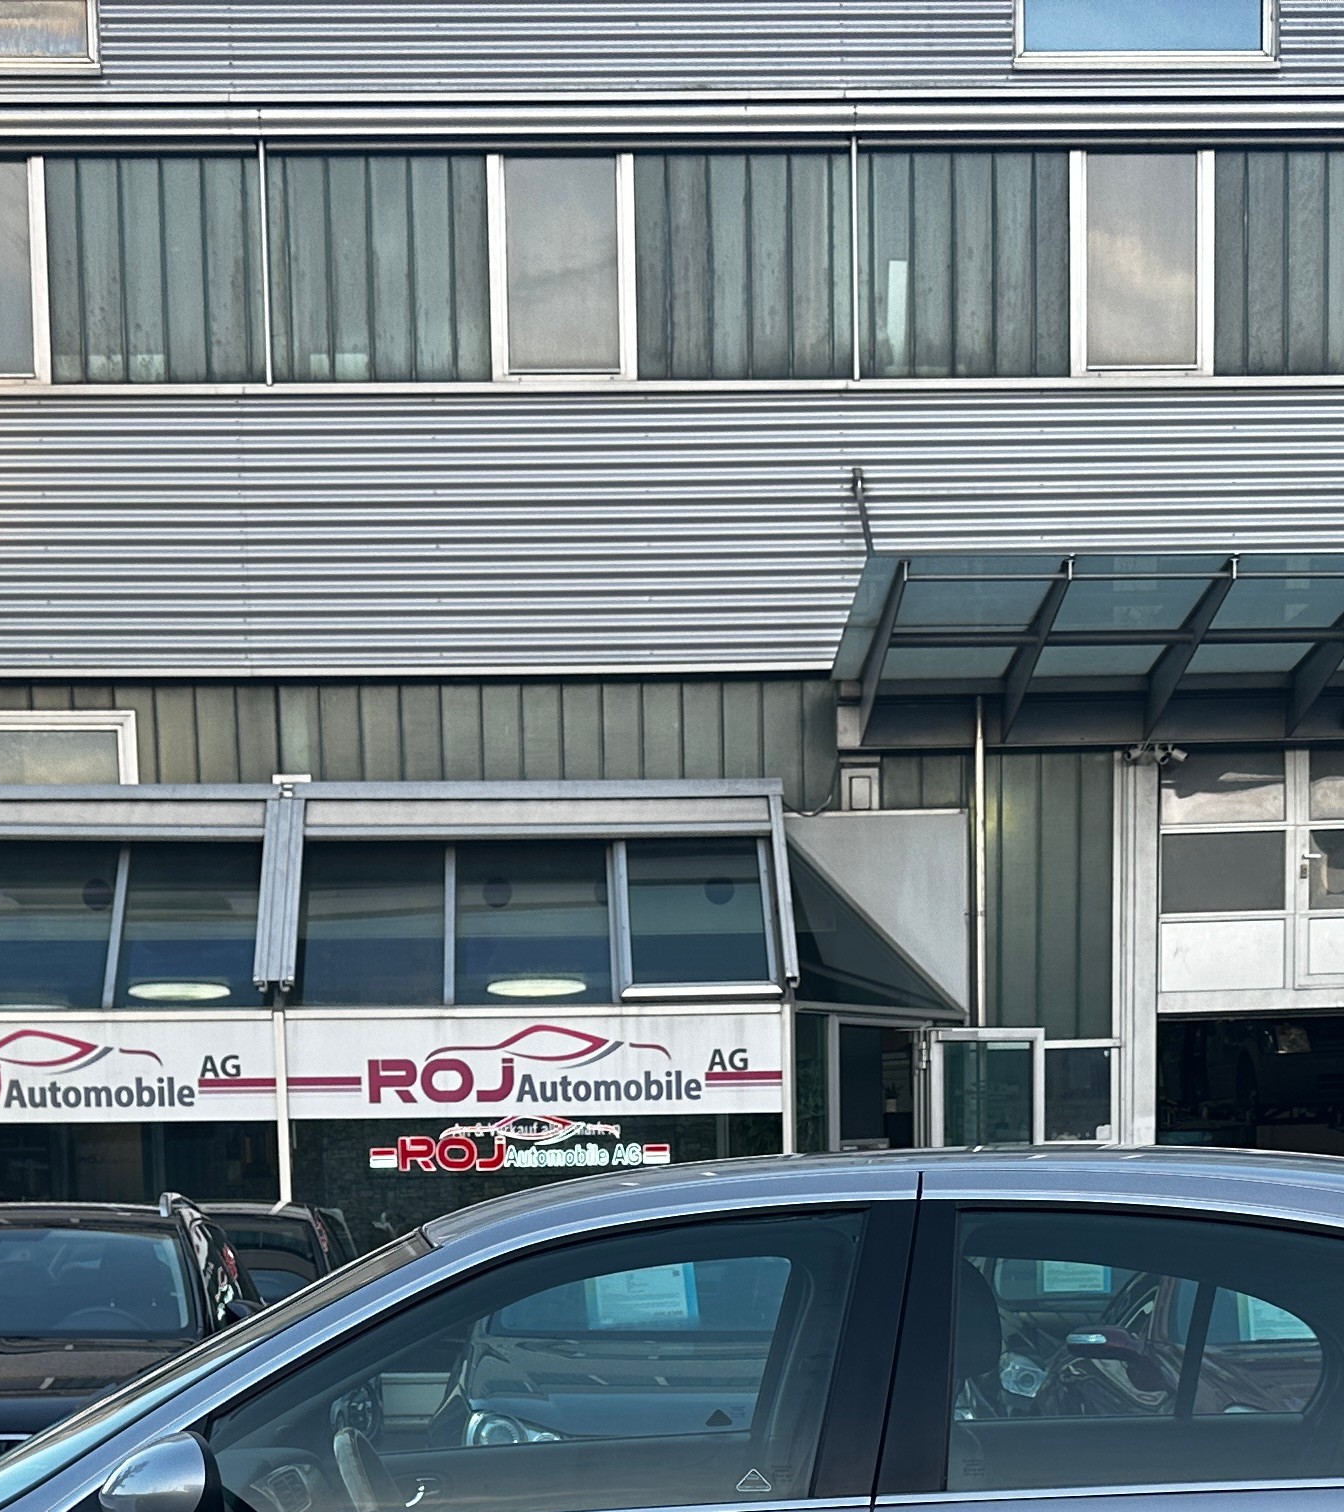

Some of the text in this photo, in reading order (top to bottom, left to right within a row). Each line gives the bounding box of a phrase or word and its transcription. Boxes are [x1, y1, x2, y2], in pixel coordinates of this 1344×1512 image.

[3, 1070, 196, 1108] Automobile
[200, 1055, 242, 1079] AG
[367, 1048, 749, 1104] ROJ Automobile AG
[398, 1136, 644, 1172] ROJ Automobile AG
